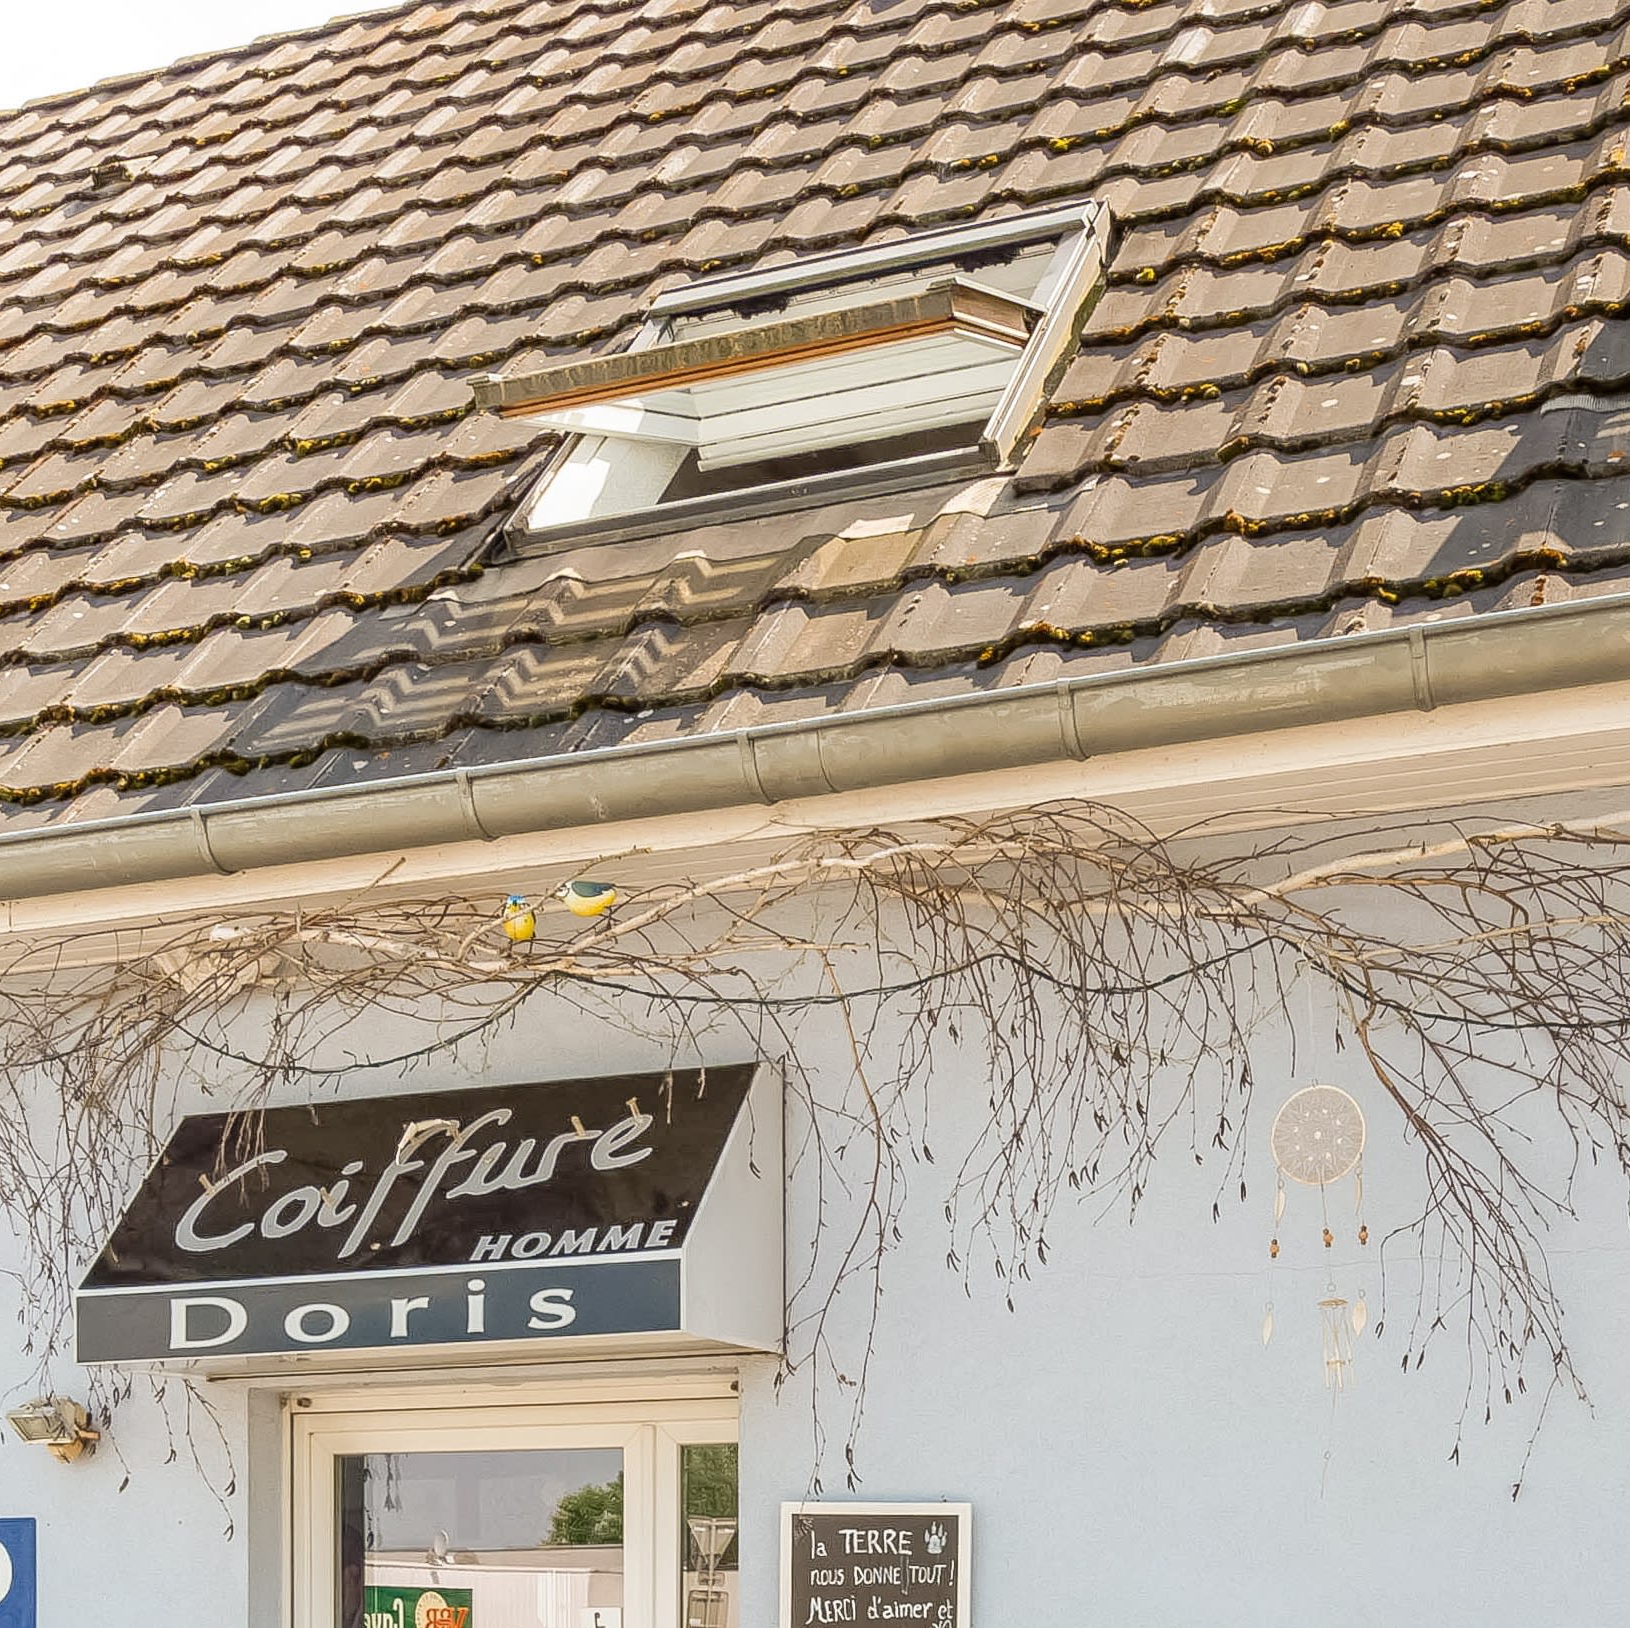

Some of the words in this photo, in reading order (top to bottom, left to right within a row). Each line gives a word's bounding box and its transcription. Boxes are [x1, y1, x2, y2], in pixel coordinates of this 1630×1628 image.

[174, 1108, 653, 1259] Coiffure
[469, 1219, 678, 1262] HOMME
[168, 1279, 577, 1350] Doris
[811, 1530, 827, 1559] la
[839, 1529, 914, 1555] TERRE
[811, 1569, 845, 1586] nous
[854, 1566, 901, 1585] DONNE
[868, 1596, 933, 1619] d'aimer
[938, 1600, 954, 1619] et
